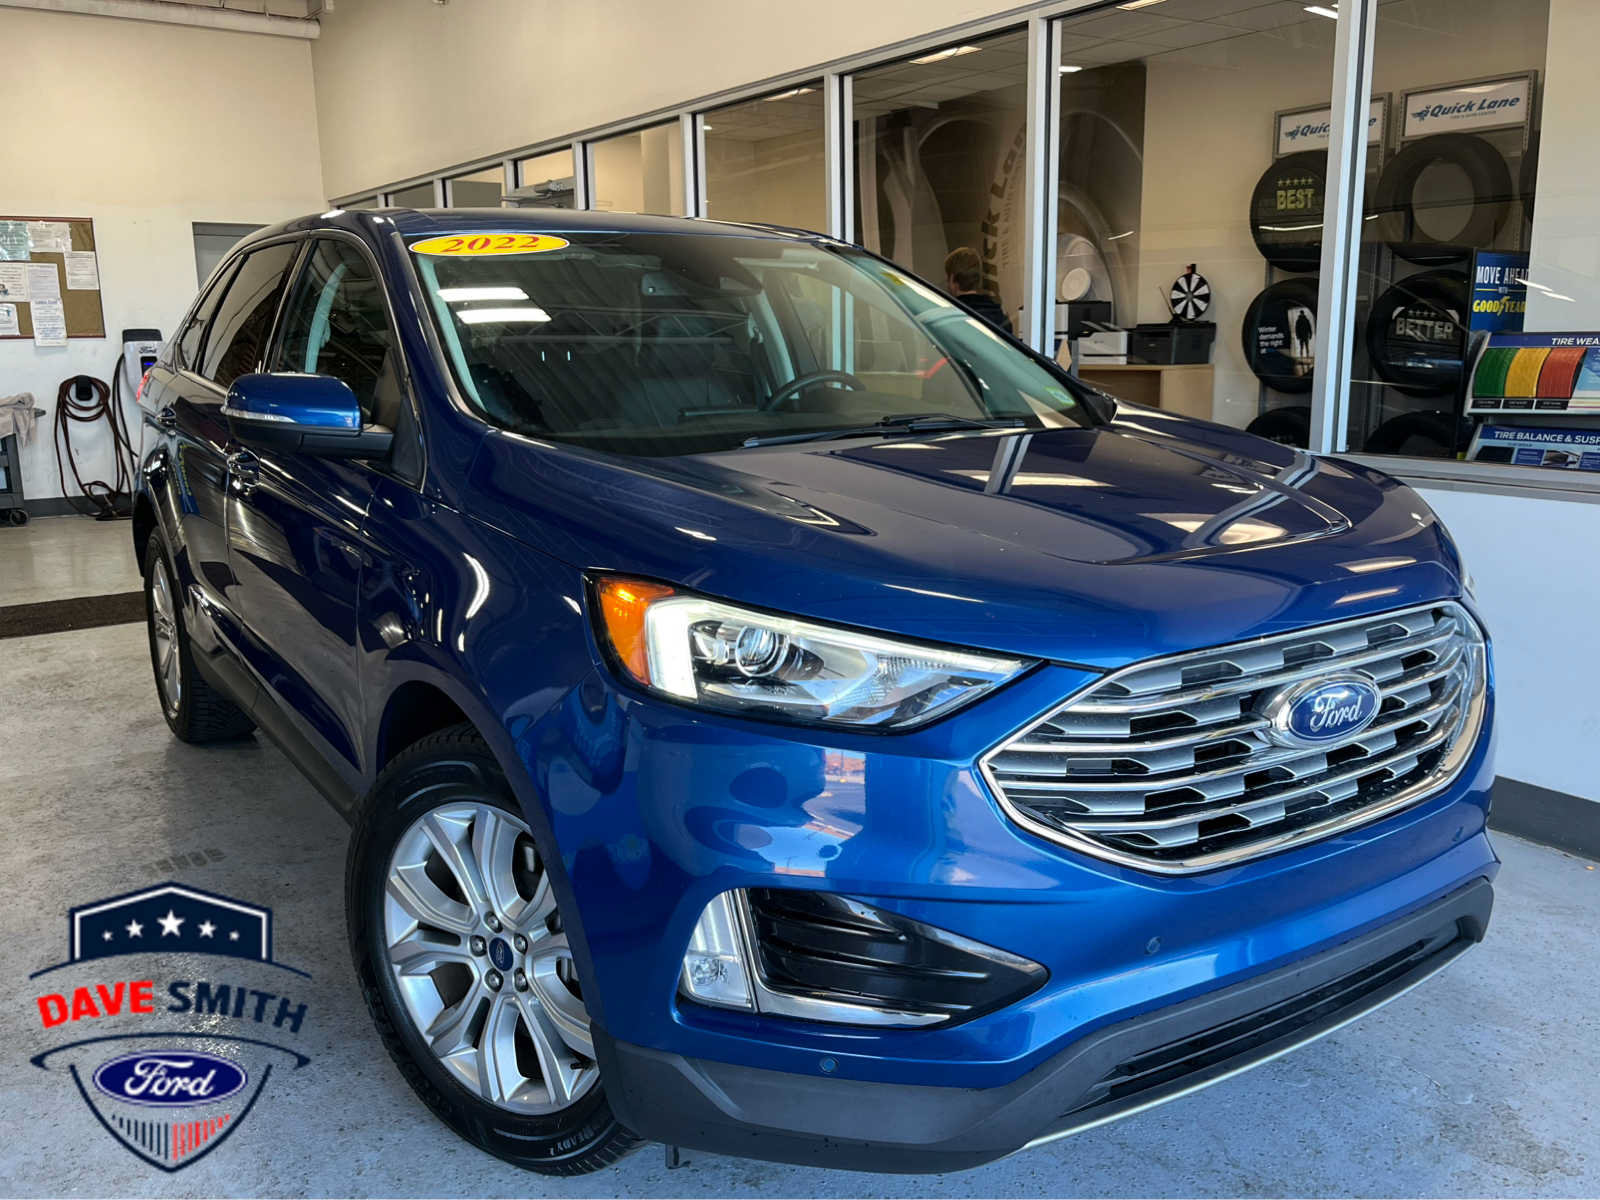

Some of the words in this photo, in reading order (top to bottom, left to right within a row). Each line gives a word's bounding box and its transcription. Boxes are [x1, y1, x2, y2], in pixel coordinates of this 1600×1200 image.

[1430, 100, 1476, 117] Quick
[1477, 96, 1521, 111] Lane
[1300, 122, 1330, 137] Quic
[1276, 188, 1315, 211] BEST
[440, 236, 540, 253] 2022
[1476, 266, 1501, 284] MOVE
[1395, 317, 1453, 340] BETTER
[1551, 337, 1574, 345] TIRE
[138, 346, 158, 354] Ford
[1494, 431, 1514, 440] TIRE
[1516, 432, 1564, 443] BALANCE
[1565, 434, 1573, 443] &
[1309, 690, 1362, 732] Ford
